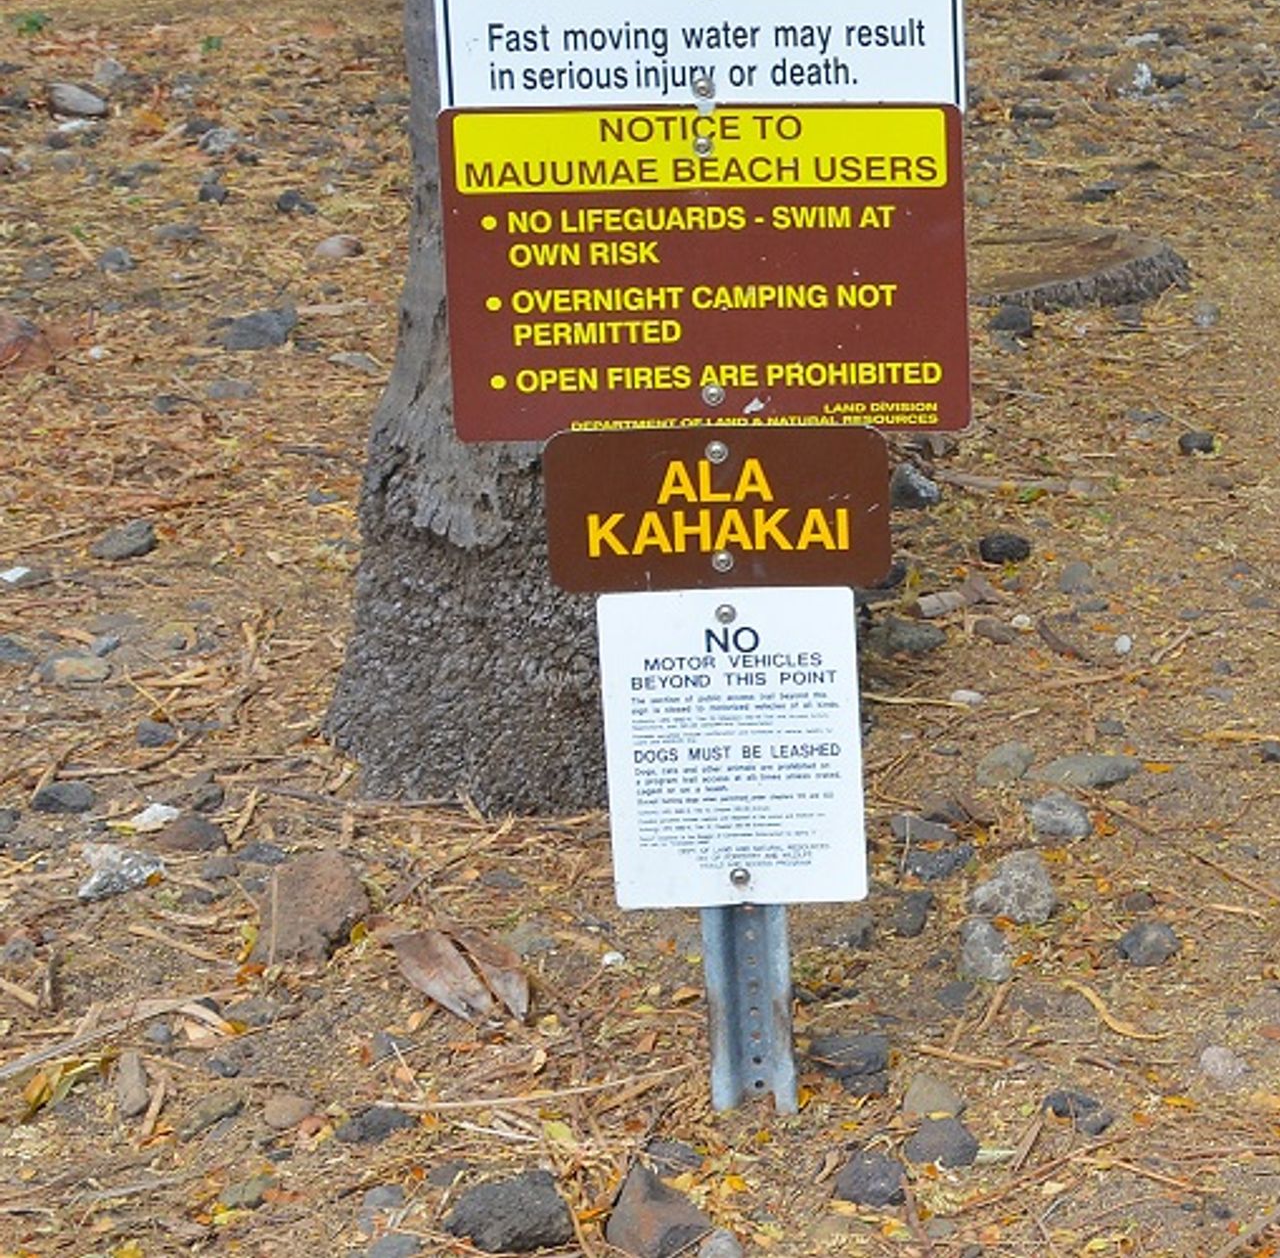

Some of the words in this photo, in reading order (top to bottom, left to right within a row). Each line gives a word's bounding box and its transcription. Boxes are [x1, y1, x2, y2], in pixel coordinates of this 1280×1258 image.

[489, 24, 549, 51] Fast
[564, 22, 667, 57] moving
[682, 22, 759, 49] water
[775, 26, 831, 54] may
[846, 19, 925, 46] result
[491, 63, 514, 89] in
[523, 61, 627, 89] serious
[636, 60, 715, 95] injury
[730, 65, 756, 86] or
[771, 58, 857, 86] death.
[600, 116, 740, 143] NOTICE
[753, 116, 801, 139] TO
[466, 159, 658, 187] MAUUMAE
[673, 157, 799, 182] BEACH
[815, 157, 937, 182] USERS
[508, 210, 552, 234] NO
[561, 207, 746, 232] LIFEGUARDS
[772, 206, 852, 229] SWIM
[860, 206, 895, 228] AT
[508, 242, 580, 268] OWN
[590, 241, 659, 264] RISK
[512, 287, 684, 313] OVERNIGHT
[692, 285, 828, 309] CAMPING
[837, 285, 896, 308] NOT
[513, 320, 682, 346] PERMITTED
[516, 367, 599, 393] OPEN
[607, 365, 692, 389] FIRES
[700, 364, 756, 386] ARE
[767, 362, 942, 386] PROHIBITED
[824, 402, 868, 415] LAND
[869, 402, 938, 413] DIVISION
[571, 419, 676, 432] DEPARTMENT
[680, 418, 702, 428] OF
[707, 417, 749, 427] LAND
[767, 416, 836, 426] NATURAL
[842, 414, 940, 426] RESOURCES
[658, 458, 772, 504] ALA
[588, 508, 849, 557] KAHAKAI
[705, 627, 760, 653] NO
[645, 656, 715, 670] MOTOR
[729, 652, 821, 668] VEHICLES
[632, 675, 710, 690] BEYOND
[727, 673, 766, 685] THIS
[780, 670, 835, 685] POINT
[634, 748, 678, 763] DOGS
[689, 746, 730, 761] MUST
[743, 746, 761, 758] BE
[771, 743, 840, 758] LEASHED
